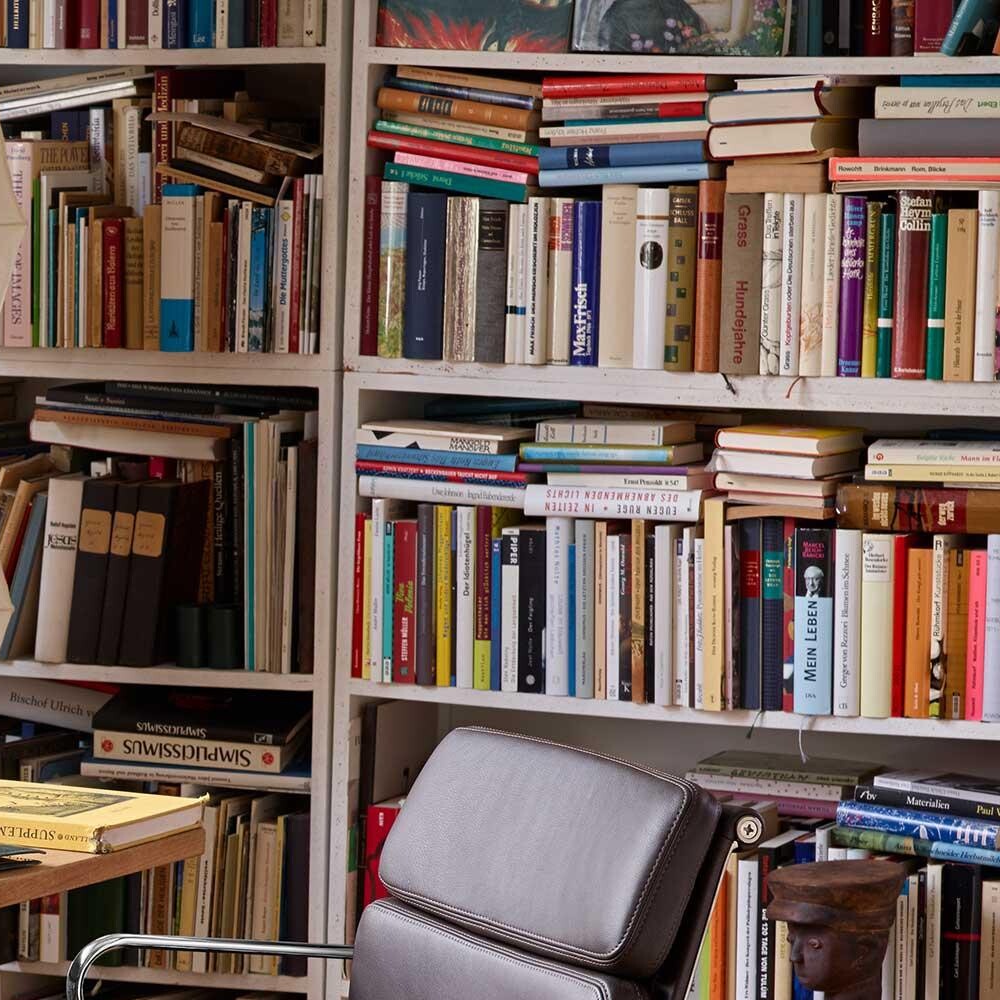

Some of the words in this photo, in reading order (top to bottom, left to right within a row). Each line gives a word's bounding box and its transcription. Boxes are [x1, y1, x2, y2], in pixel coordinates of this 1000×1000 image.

[900, 195, 932, 208] Stefan
[900, 206, 932, 220] Heym
[736, 205, 751, 248] Grass
[900, 219, 932, 232] Collin
[279, 239, 290, 290] Muttergottes
[11, 273, 23, 325] IMAGES
[279, 291, 288, 305] Die
[573, 283, 588, 324] Frisch
[762, 290, 770, 311] Grass
[731, 280, 748, 365] Hundejahre
[761, 312, 770, 338] Günter
[573, 324, 587, 357] Max
[784, 351, 792, 370] Grass
[546, 488, 581, 499] LICHTS
[585, 490, 661, 503] ABNEHMENDEN
[664, 493, 680, 503] DES
[545, 501, 580, 512] ZEITEN
[583, 503, 596, 512] IN
[617, 503, 642, 514] RUGE
[647, 504, 678, 515] EUGEN
[463, 532, 472, 580] Idiotenhügel
[509, 536, 518, 565] PIPER
[841, 554, 850, 580] Schnee
[841, 590, 849, 618] Blumen
[401, 616, 409, 638] MÖLLER
[804, 601, 817, 642] LEBEN
[840, 621, 849, 649] Rezzori
[401, 638, 409, 662] STEFFEN
[840, 649, 848, 662] von
[804, 647, 817, 683] MEIN
[839, 662, 849, 689] Gregor
[9, 691, 48, 709] Bischof
[50, 699, 84, 717] Ulrich
[136, 722, 207, 739] SIMPLICISSIMUS
[122, 739, 254, 768] SIMPLICISSIMUS
[905, 795, 950, 810] Materialien
[976, 804, 994, 816] Paul
[760, 922, 769, 937] 120
[760, 937, 769, 956] TAGE
[760, 956, 769, 972] VON
